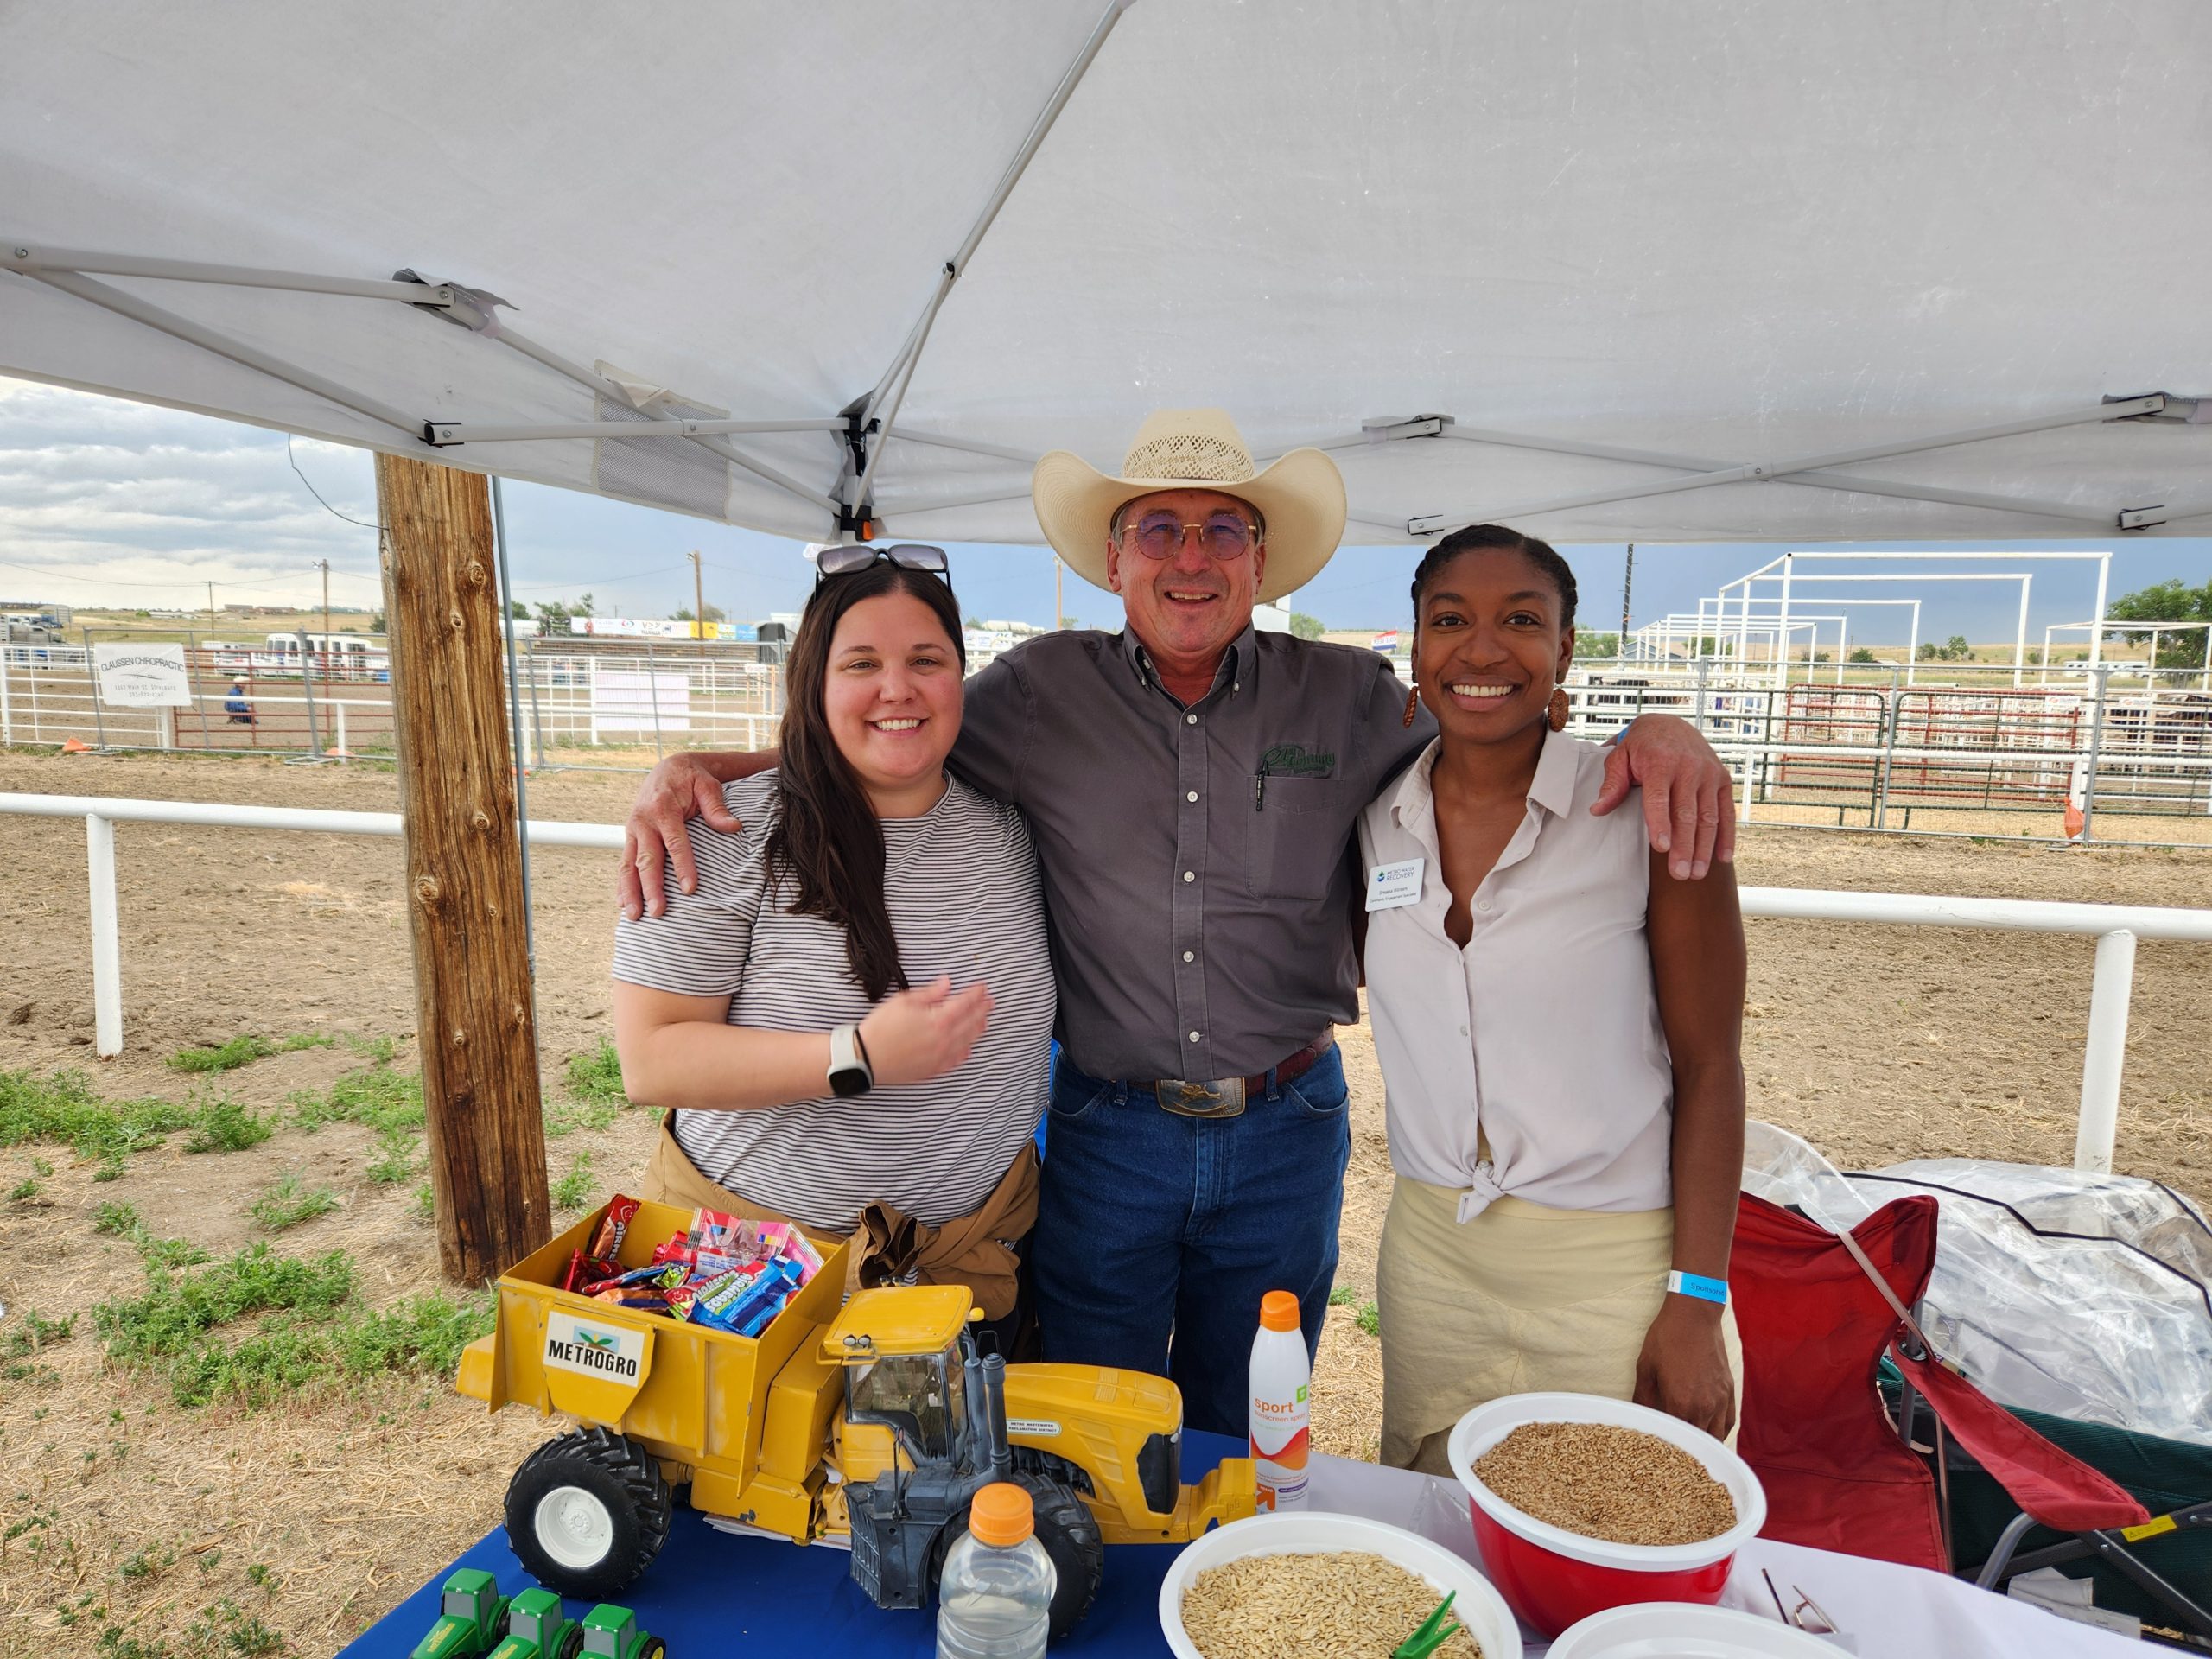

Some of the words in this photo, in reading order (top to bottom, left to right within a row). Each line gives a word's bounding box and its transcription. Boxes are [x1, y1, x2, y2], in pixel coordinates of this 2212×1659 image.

[101, 657, 134, 671] CLAUSSEN
[135, 656, 184, 672] CHIROPRACTIC
[1387, 872, 1414, 880] RECOVERY
[704, 1272, 753, 1312] AIRHEADS
[548, 1339, 638, 1376] METROGRO
[1255, 1398, 1294, 1413] sport
[1254, 1409, 1289, 1423] sunscreen
